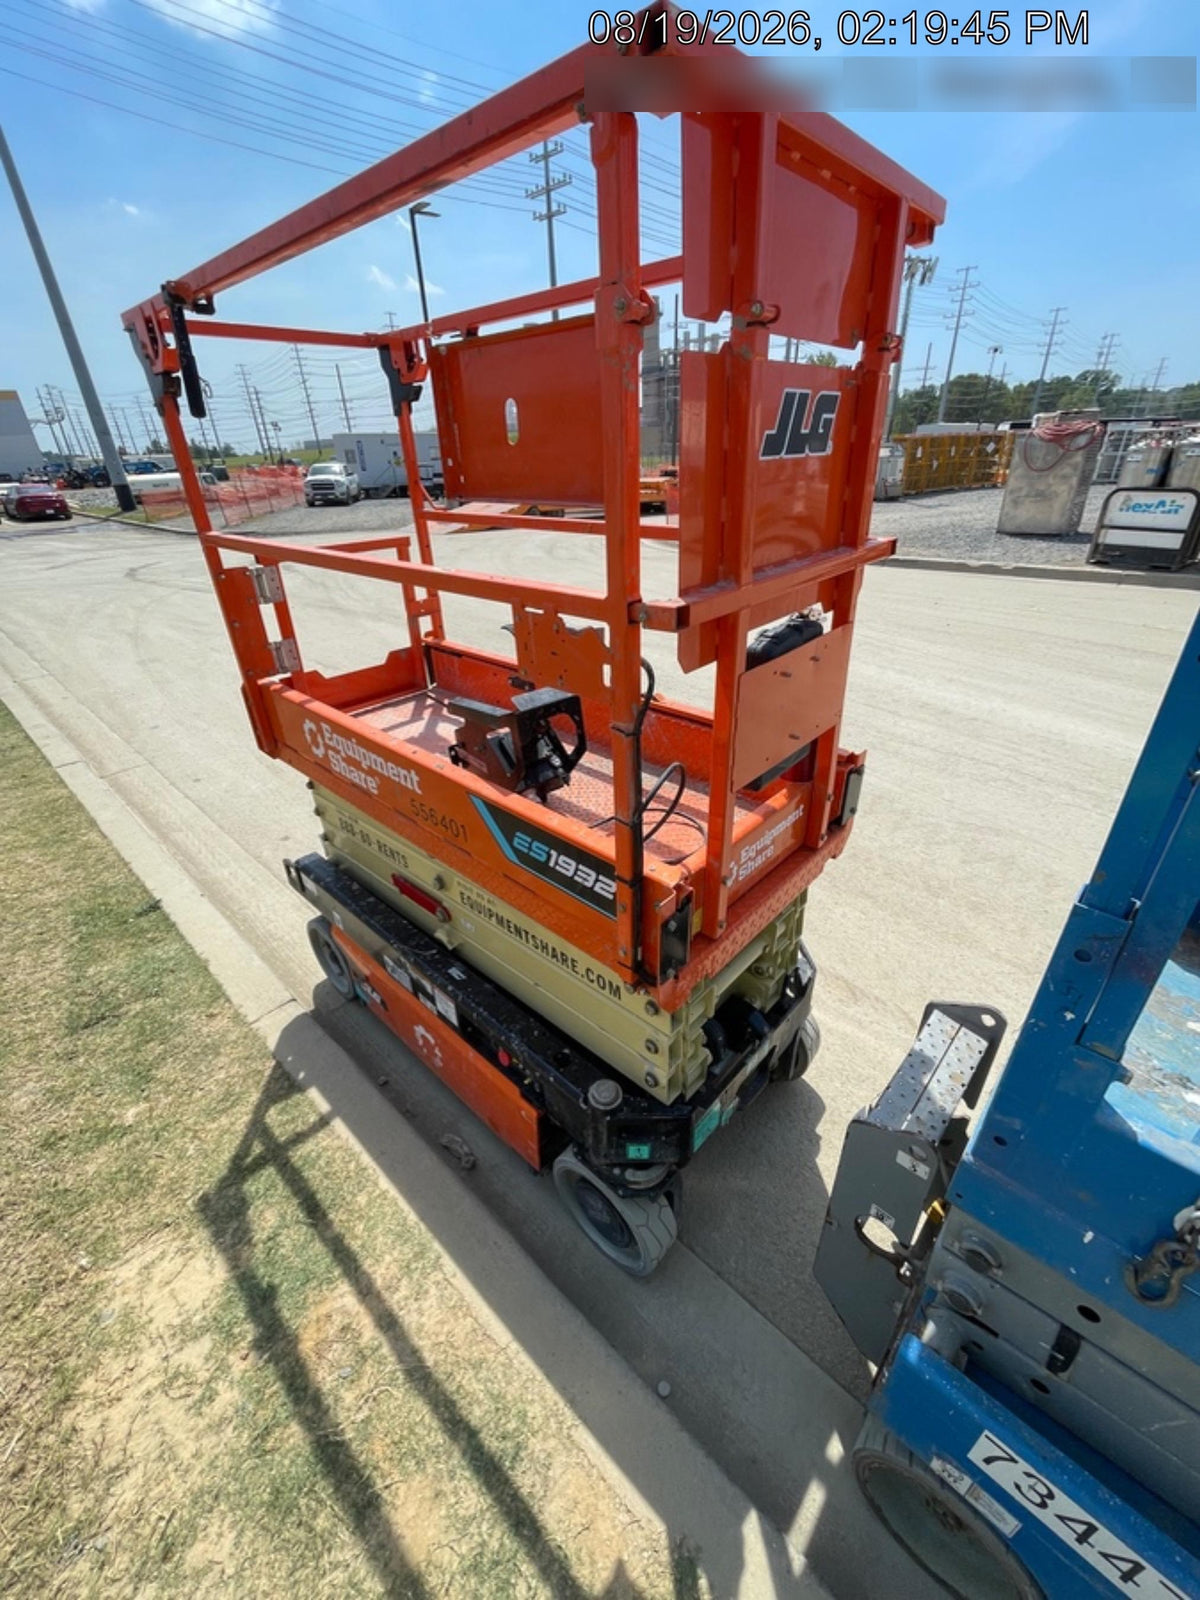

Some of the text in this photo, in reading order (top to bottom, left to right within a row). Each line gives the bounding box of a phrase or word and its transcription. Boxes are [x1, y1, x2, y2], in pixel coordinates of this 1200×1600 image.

[759, 387, 841, 460] JLG
[320, 723, 423, 795] Equipment
[327, 750, 379, 795] Share
[513, 831, 617, 900] ES1932
[738, 845, 774, 881] Share
[740, 804, 804, 864] Equipment
[459, 891, 622, 1001] EQUIPMENTSHARE.COM
[981, 1433, 1190, 1600] 7344
